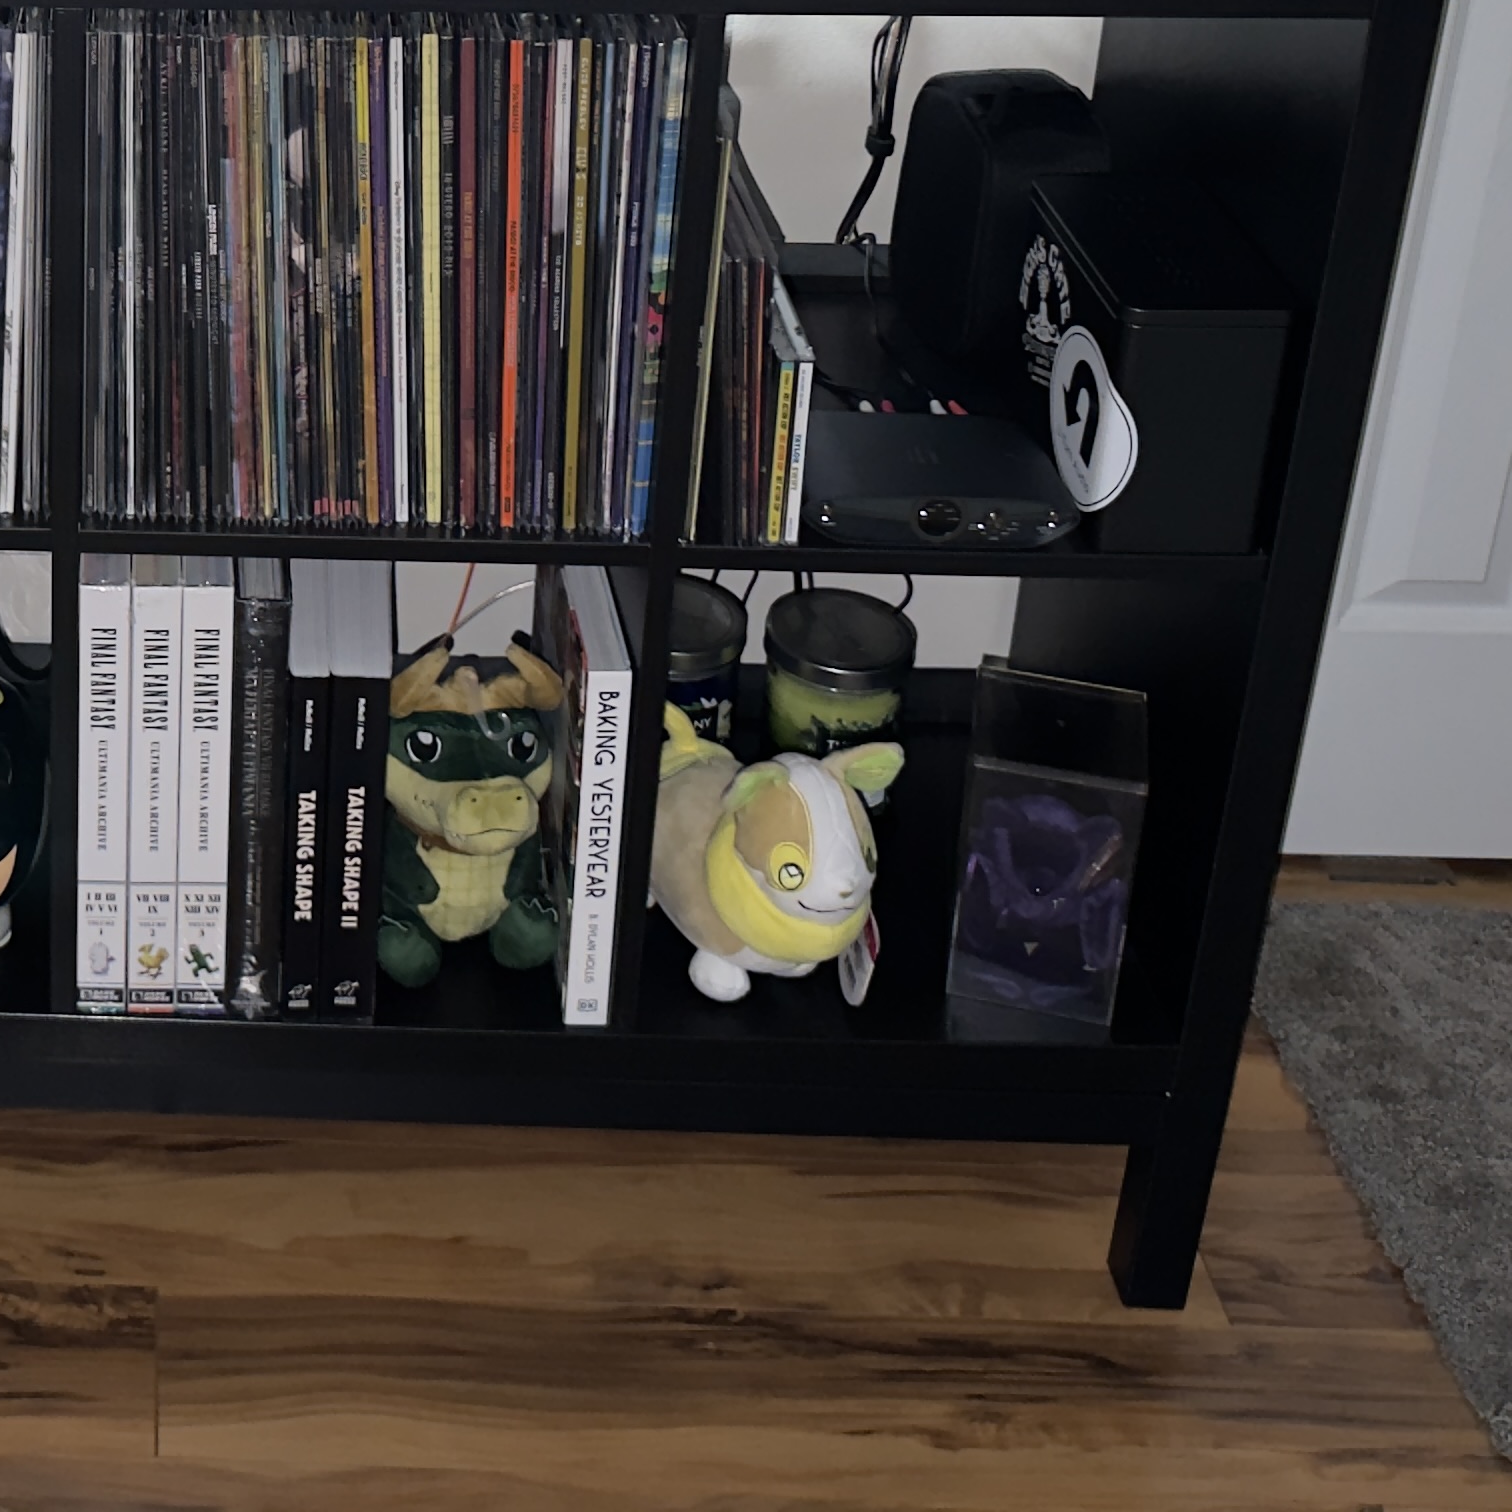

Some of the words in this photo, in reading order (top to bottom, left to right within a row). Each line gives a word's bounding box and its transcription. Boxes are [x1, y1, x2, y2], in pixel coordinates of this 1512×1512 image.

[580, 56, 590, 85] ELVIS
[577, 86, 589, 131] PRESLEY
[791, 434, 802, 463] TAYLOR
[91, 628, 116, 667] FINAL
[143, 629, 169, 669] FINAL
[194, 629, 220, 668] FINAL
[90, 673, 116, 731] FANTASY
[142, 674, 169, 732] FANTASY
[193, 674, 219, 732] FANTASY
[593, 691, 620, 766] BAKING
[98, 740, 108, 800] ULTIMANIA
[149, 741, 160, 801] ULTIMANIA
[199, 741, 210, 801] ULTIMANIA
[97, 804, 107, 851] ARCHIVE
[149, 805, 159, 852] ARCHIVE
[198, 805, 208, 852] ARCHIVE
[296, 790, 317, 860] TAKING
[345, 787, 365, 853] TAKING
[585, 778, 615, 899] YESTERYEAR
[94, 892, 101, 901] II
[105, 892, 116, 901] III
[136, 894, 149, 902] VII
[184, 894, 190, 902] X
[194, 894, 204, 902] XI
[208, 894, 221, 902] XII
[293, 864, 314, 922] SHAPE
[342, 856, 362, 911] SHAPE
[85, 904, 94, 913] IV
[98, 904, 105, 913] V
[107, 904, 118, 913] VI
[148, 905, 158, 914] IX
[205, 905, 220, 914] XIV
[340, 913, 358, 928] II
[587, 923, 599, 951] DYLAN
[584, 954, 598, 984] HOLLIS
